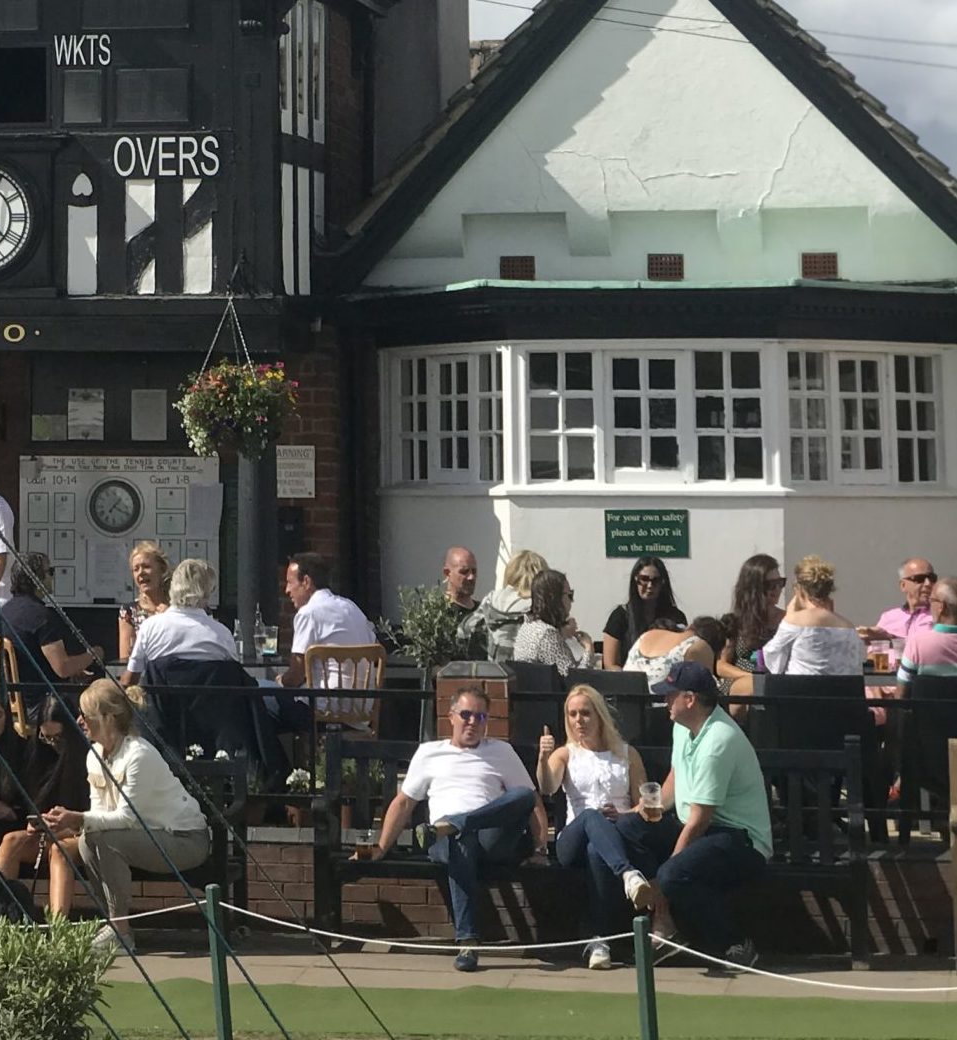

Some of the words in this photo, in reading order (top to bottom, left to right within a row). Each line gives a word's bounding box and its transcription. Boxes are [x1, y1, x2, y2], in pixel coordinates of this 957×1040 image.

[54, 34, 111, 66] WKTS
[113, 136, 220, 177] OVERS
[53, 475, 77, 485] 10-14
[149, 475, 170, 484] Court
[606, 513, 620, 522] For
[623, 514, 641, 523] your
[662, 512, 684, 523] safety
[611, 528, 636, 538] please
[637, 528, 648, 537] do
[650, 528, 670, 537] NOT
[672, 528, 682, 537] sit
[630, 543, 643, 552] the
[645, 543, 676, 553] railings.
